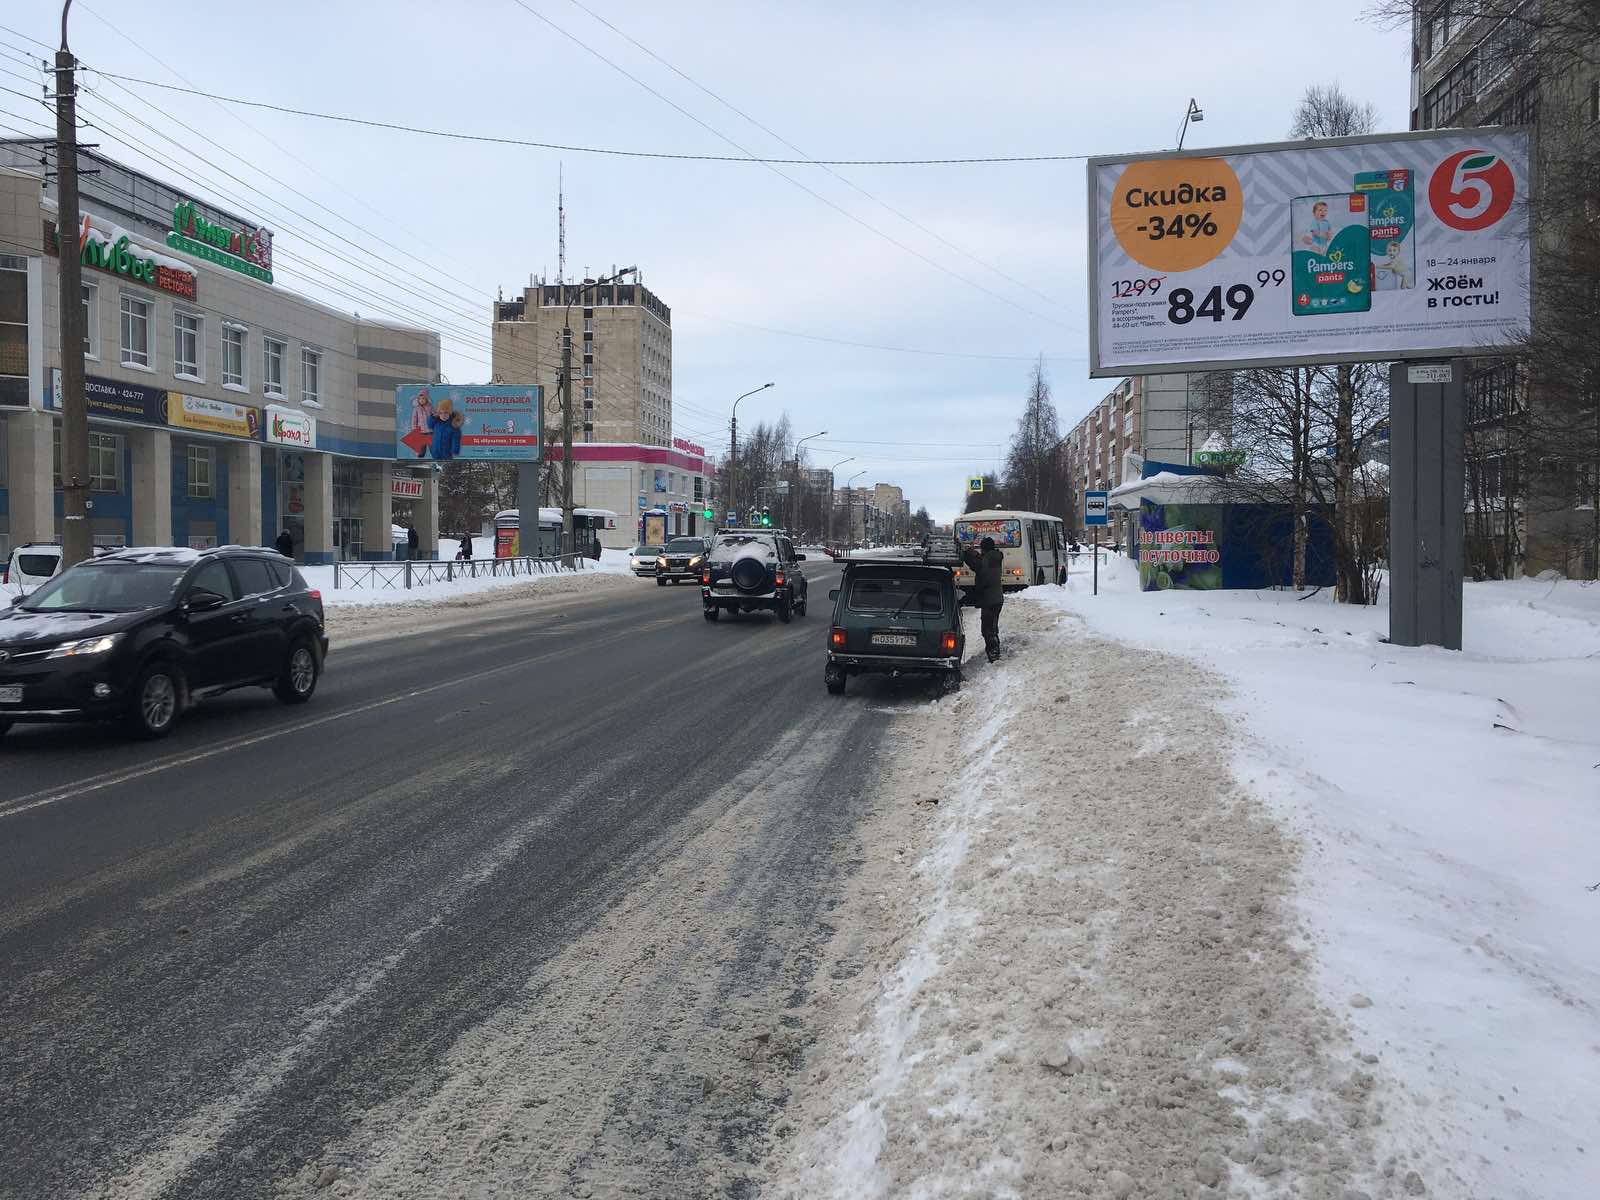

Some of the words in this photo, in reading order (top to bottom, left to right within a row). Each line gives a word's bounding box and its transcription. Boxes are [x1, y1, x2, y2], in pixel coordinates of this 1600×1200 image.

[1126, 183, 1227, 208] Скидка
[1137, 212, 1218, 240] -34%
[1370, 215, 1405, 226] ampers
[1371, 227, 1399, 237] pants
[1307, 258, 1354, 273] Pampers
[1461, 256, 1496, 266] января
[159, 276, 193, 295] РЕСТОРАН
[1318, 274, 1343, 283] pants
[1427, 275, 1483, 291] Ждём
[1112, 277, 1162, 298] 1299
[1168, 283, 1254, 324] 849
[1257, 269, 1286, 287] 99
[1428, 297, 1437, 308] в
[1443, 291, 1499, 308] гости!
[85, 382, 117, 396] ДОСТАВКА
[122, 389, 144, 400] 424-777
[465, 396, 530, 404] РАСПРОДАЖА
[1155, 530, 1214, 545] цветы
[1140, 549, 1220, 567] осуточно
